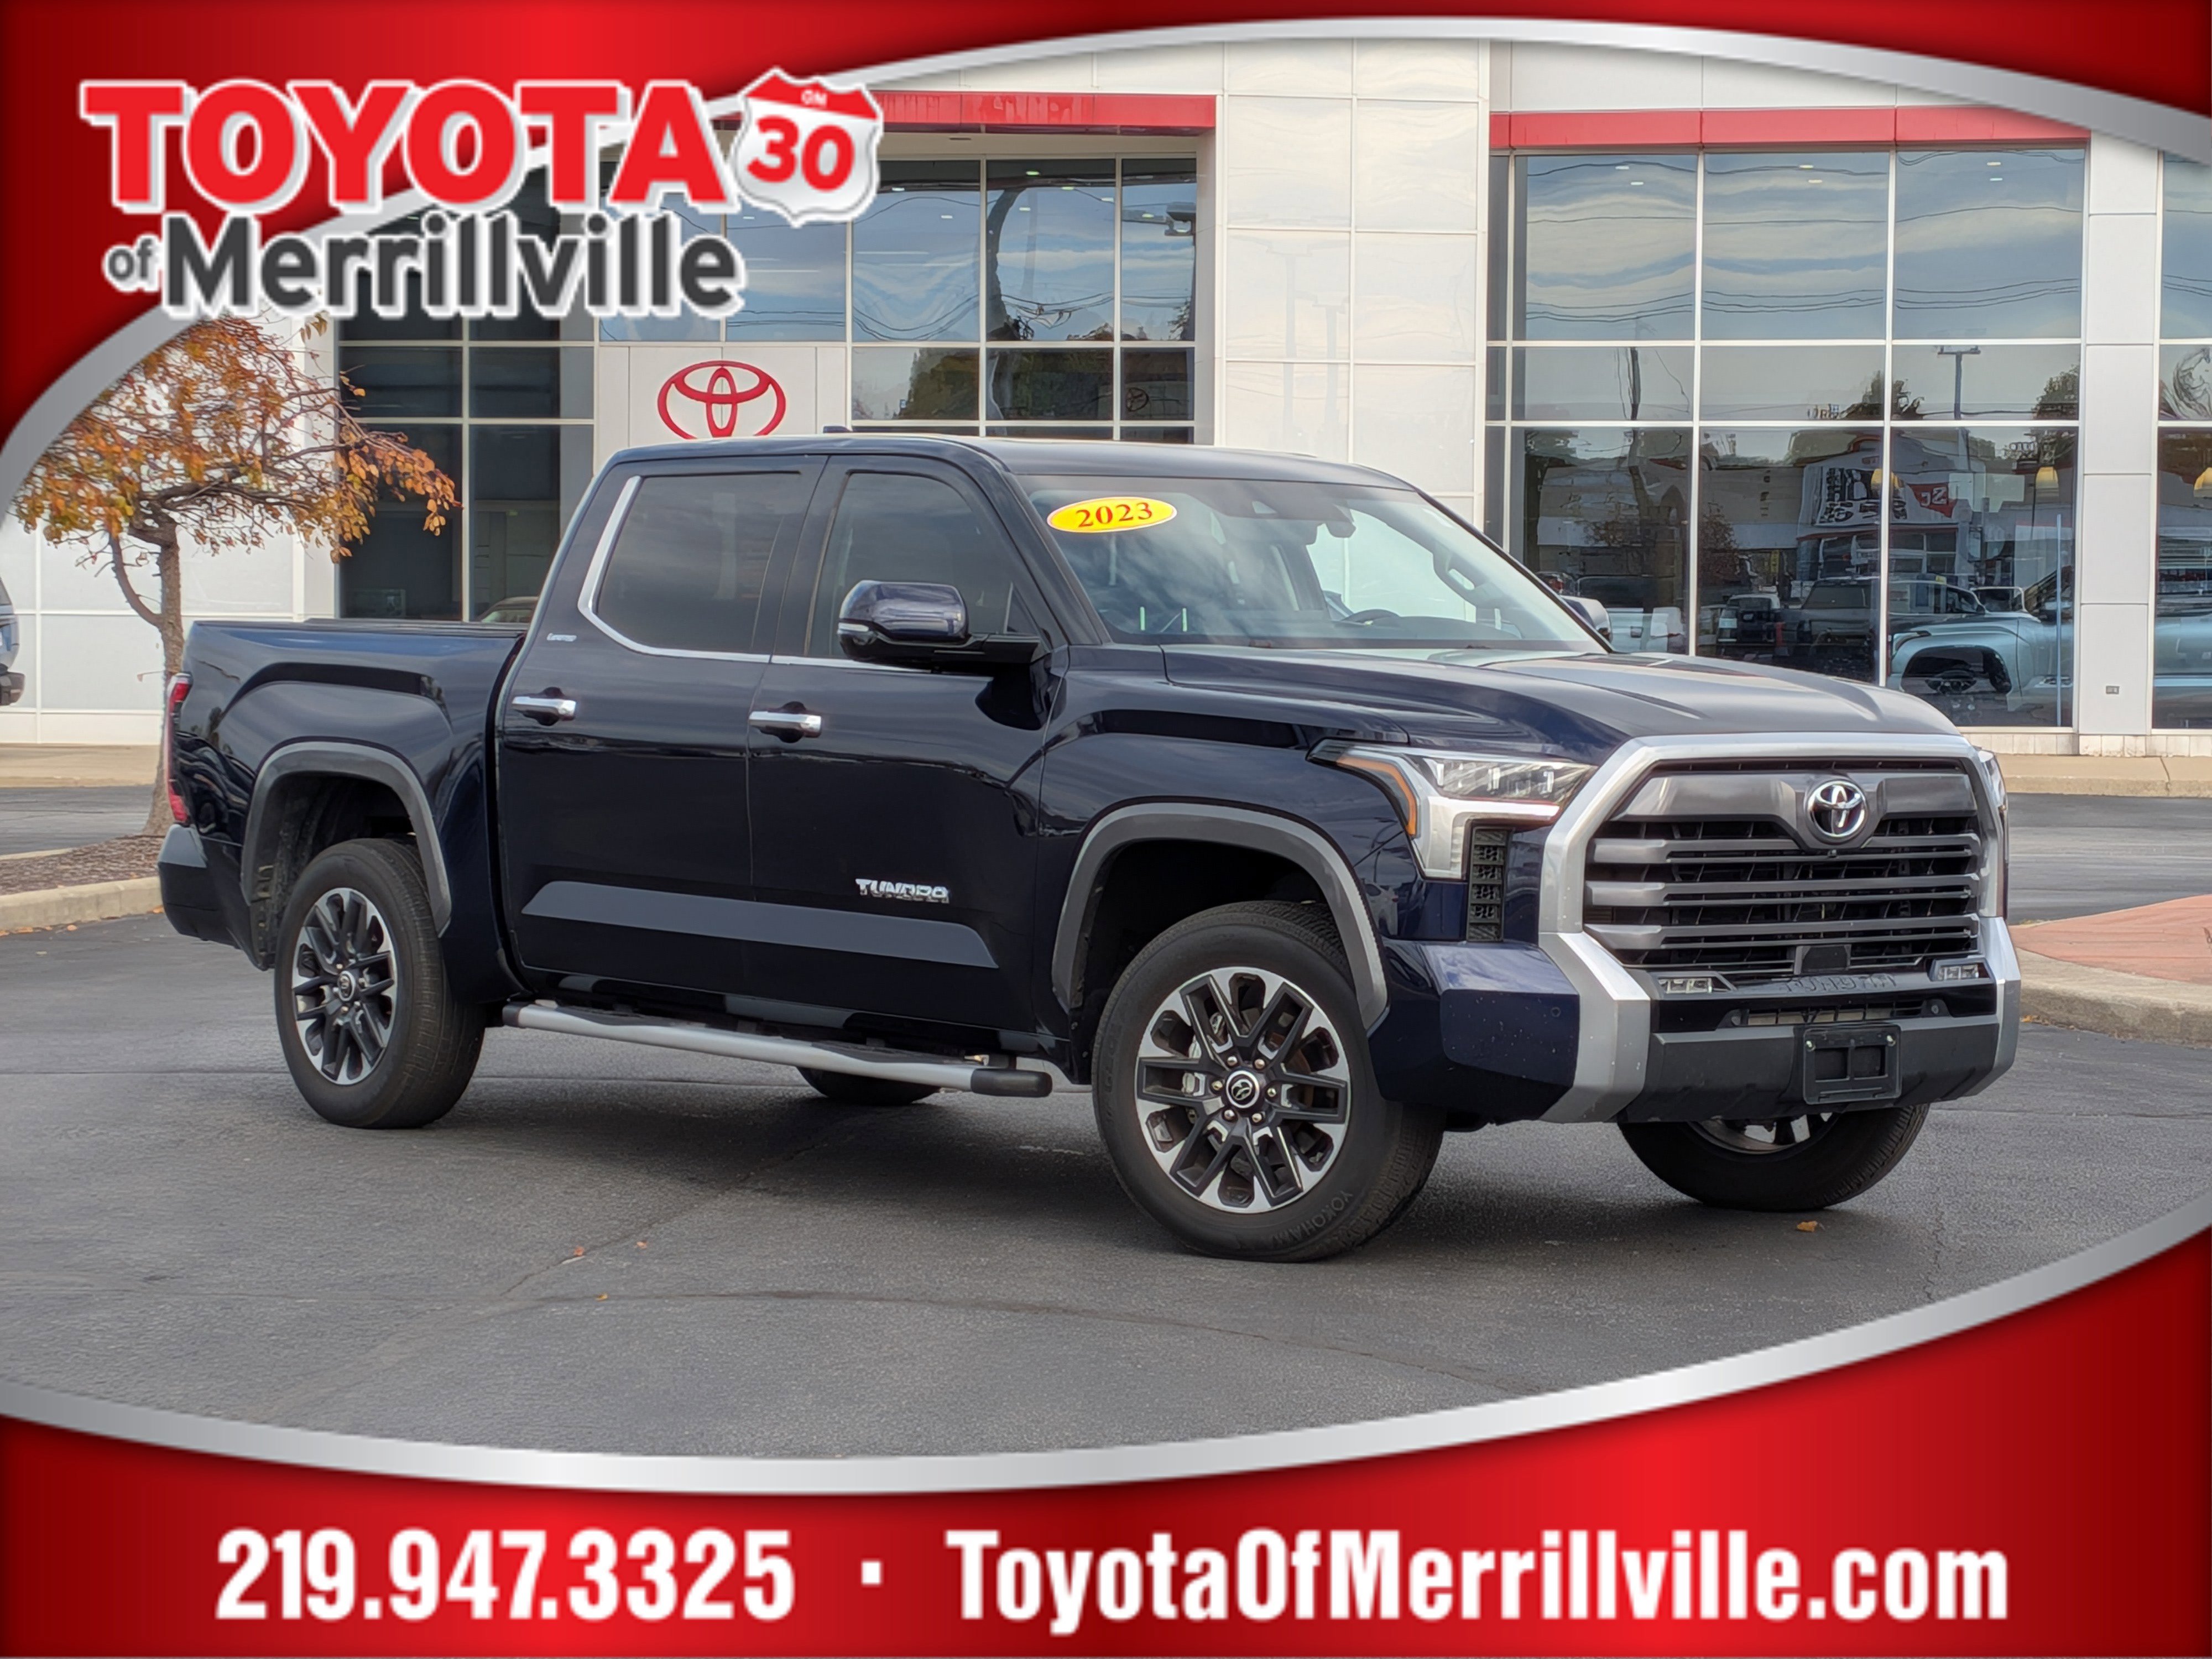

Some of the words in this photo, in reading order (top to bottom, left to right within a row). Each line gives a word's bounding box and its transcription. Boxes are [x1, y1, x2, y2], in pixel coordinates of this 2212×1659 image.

[1076, 502, 1153, 528] 2023
[855, 878, 950, 904] TUNDRA
[1269, 1190, 1353, 1245] YOKOHAM
